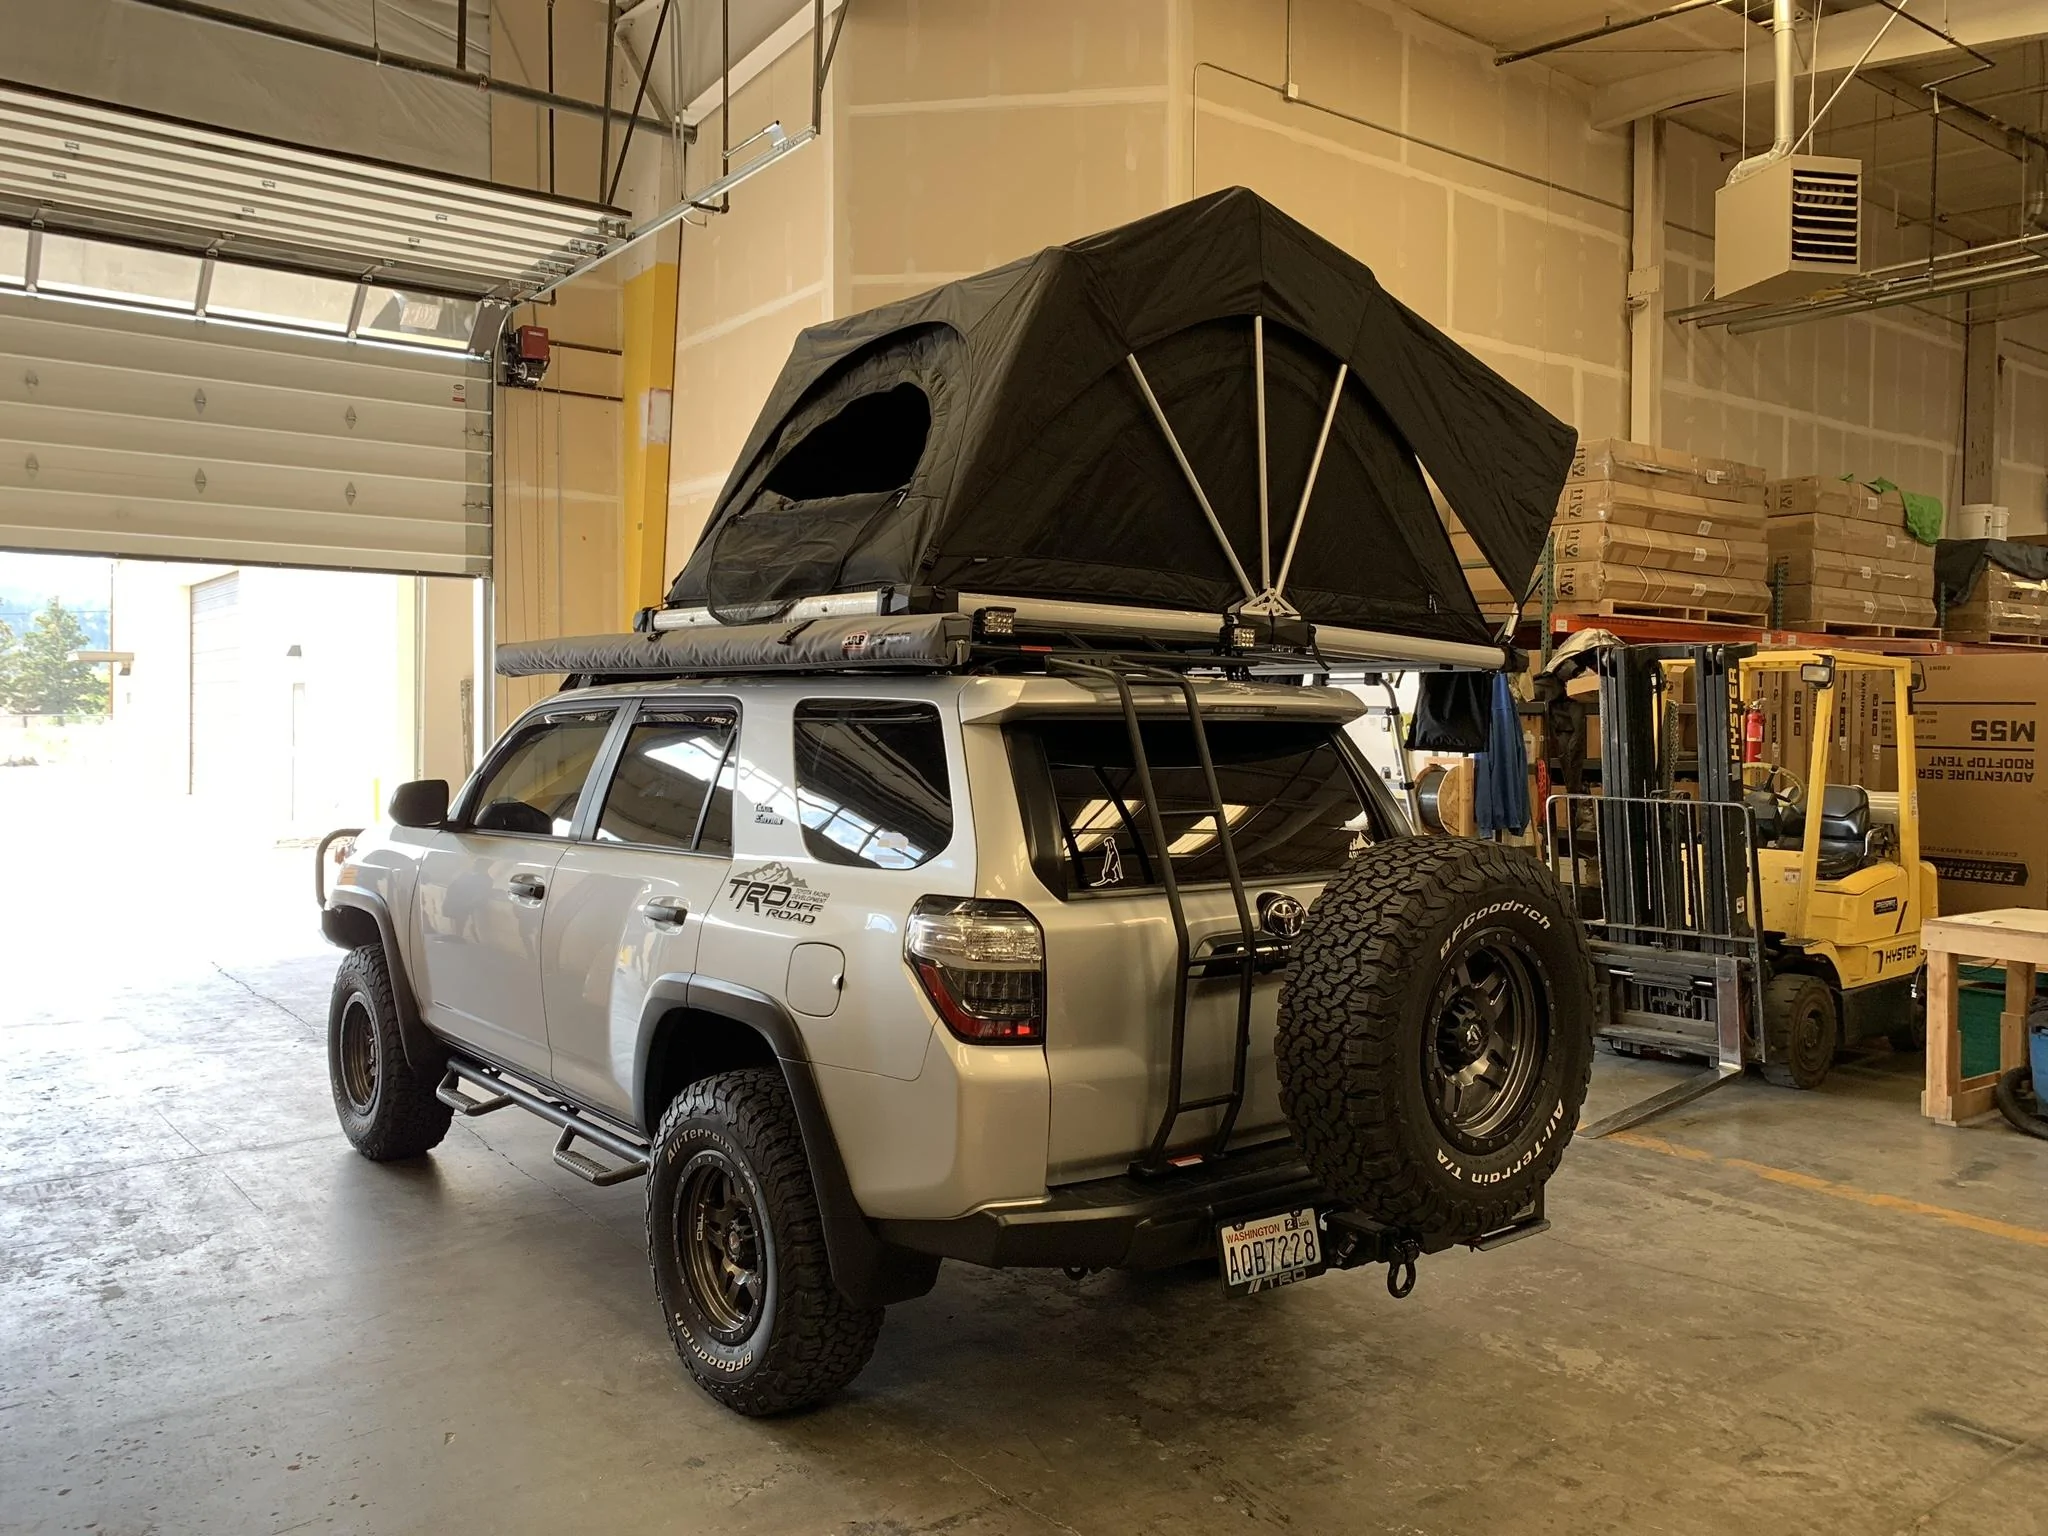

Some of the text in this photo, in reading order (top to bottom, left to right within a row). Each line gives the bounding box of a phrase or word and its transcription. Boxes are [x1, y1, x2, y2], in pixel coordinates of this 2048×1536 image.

[1728, 667, 1740, 761] HYSTER
[1971, 720, 2035, 742] M55
[1929, 756, 2034, 769] ROOFTOP TENT
[1916, 768, 2035, 783] ADVENTURE SER
[1938, 867, 2018, 882] FREESPIR
[729, 879, 792, 913] TRD
[786, 900, 824, 912] OFF
[766, 908, 816, 924] ROAD
[1440, 900, 1551, 960] BFGoodrich
[1886, 944, 1917, 964] HYSTER
[667, 1128, 733, 1165] All-Terrain
[1437, 1098, 1563, 1186] All-Terrain T/A
[1226, 1223, 1280, 1243] WASHINGTON
[1229, 1229, 1315, 1282] AQB7228
[1263, 1268, 1306, 1288] TRD
[675, 1313, 752, 1372] BFGoodrich
